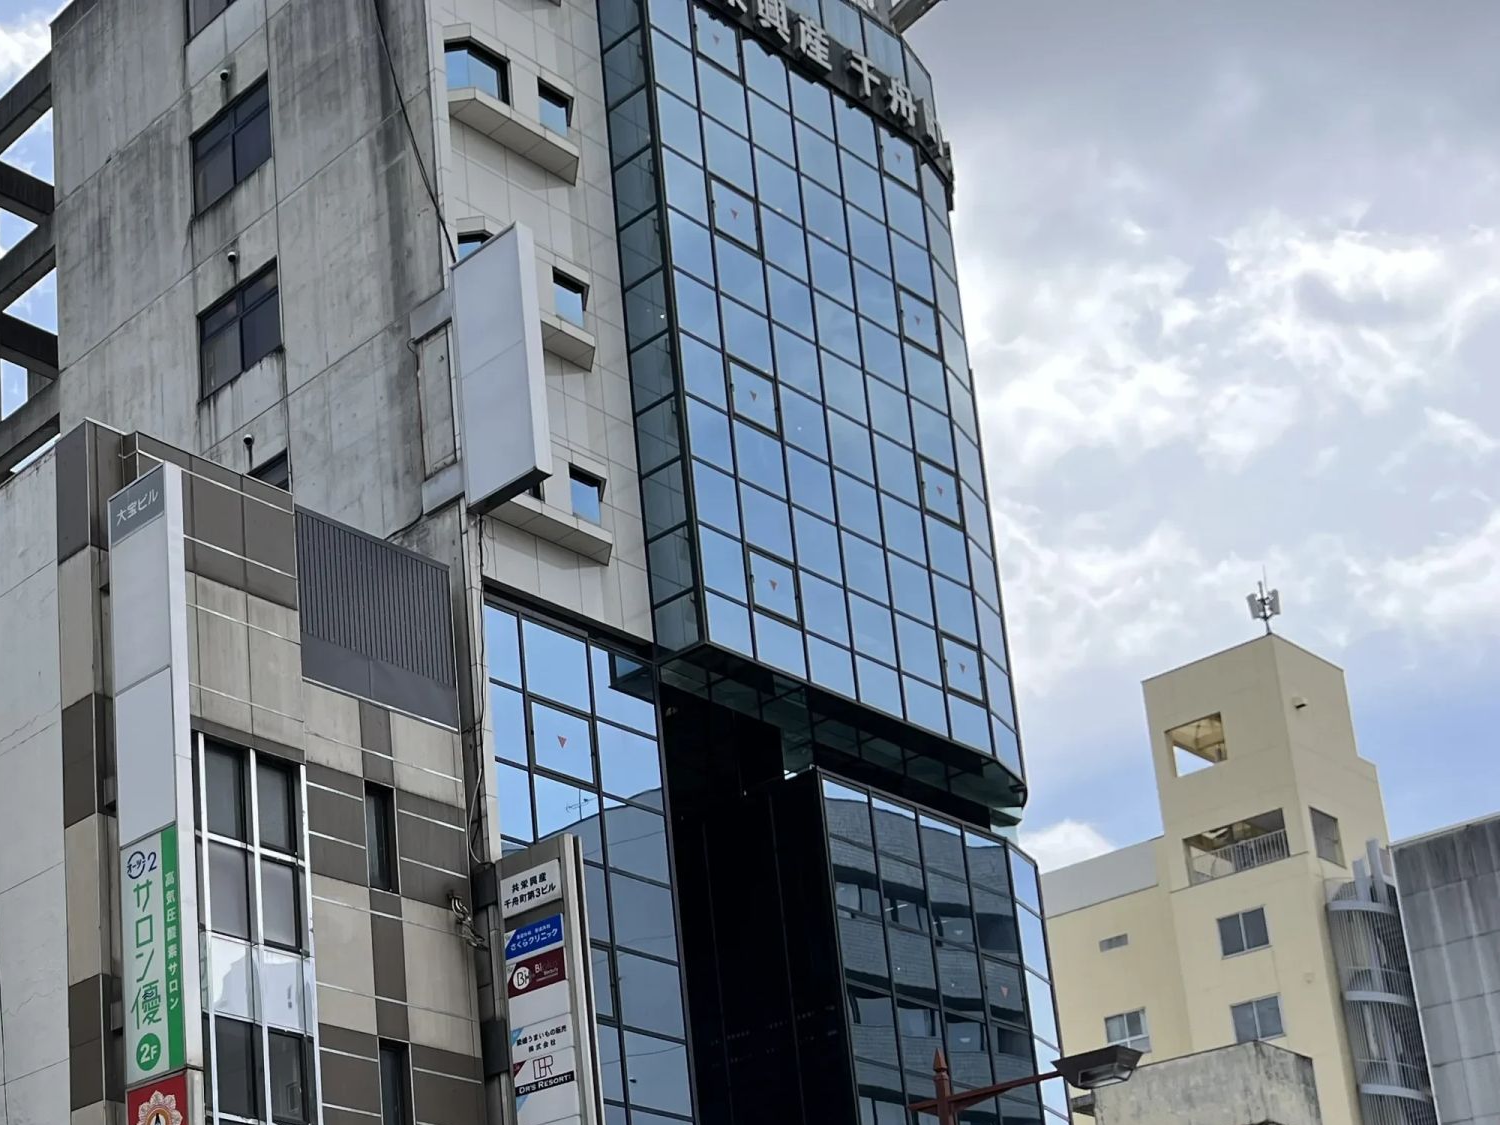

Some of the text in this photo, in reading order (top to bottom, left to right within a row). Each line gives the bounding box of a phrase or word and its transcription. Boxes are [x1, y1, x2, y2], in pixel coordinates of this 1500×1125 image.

[116, 488, 159, 527] 大宝ビル
[511, 872, 547, 893] 共栄興産
[510, 928, 558, 951] さくらクリニック
[140, 1043, 158, 1064] 2F
